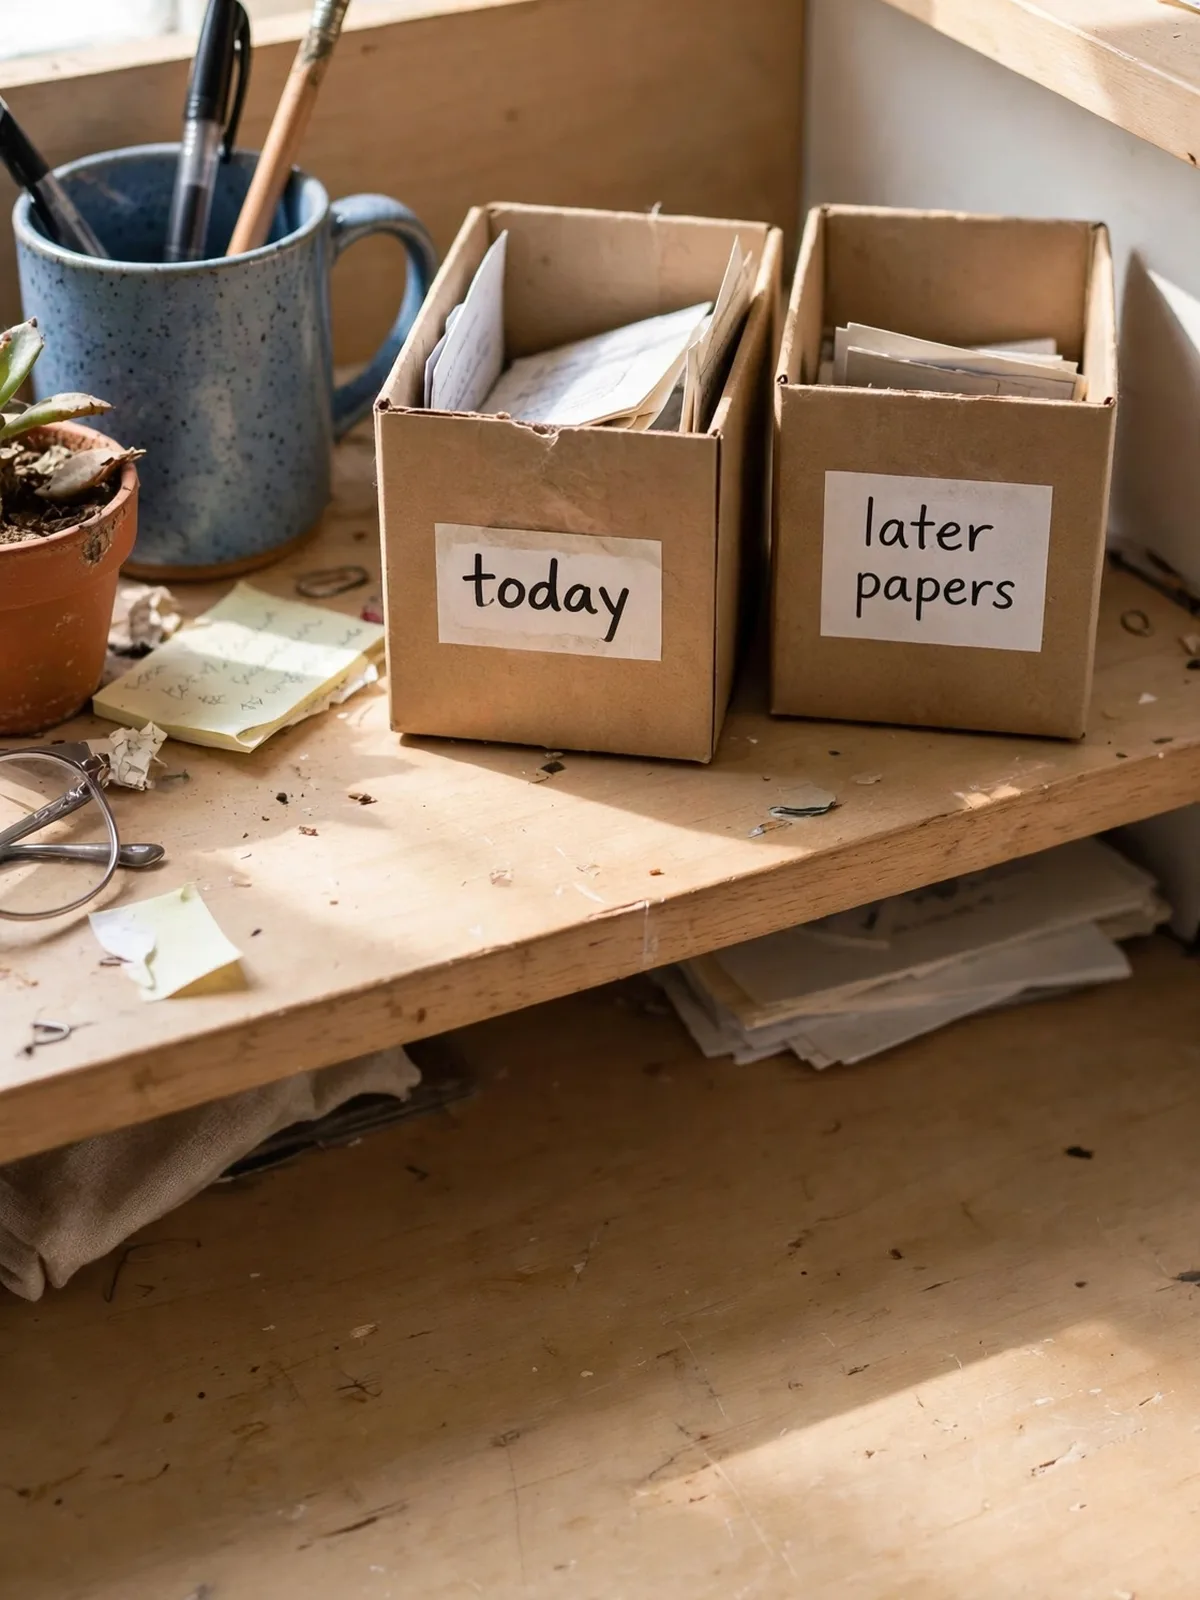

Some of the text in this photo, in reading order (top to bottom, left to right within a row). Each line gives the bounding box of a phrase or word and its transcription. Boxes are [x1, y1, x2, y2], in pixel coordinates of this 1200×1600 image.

[865, 495, 994, 553] later
[462, 553, 630, 643] today
[855, 571, 1016, 622] papers
